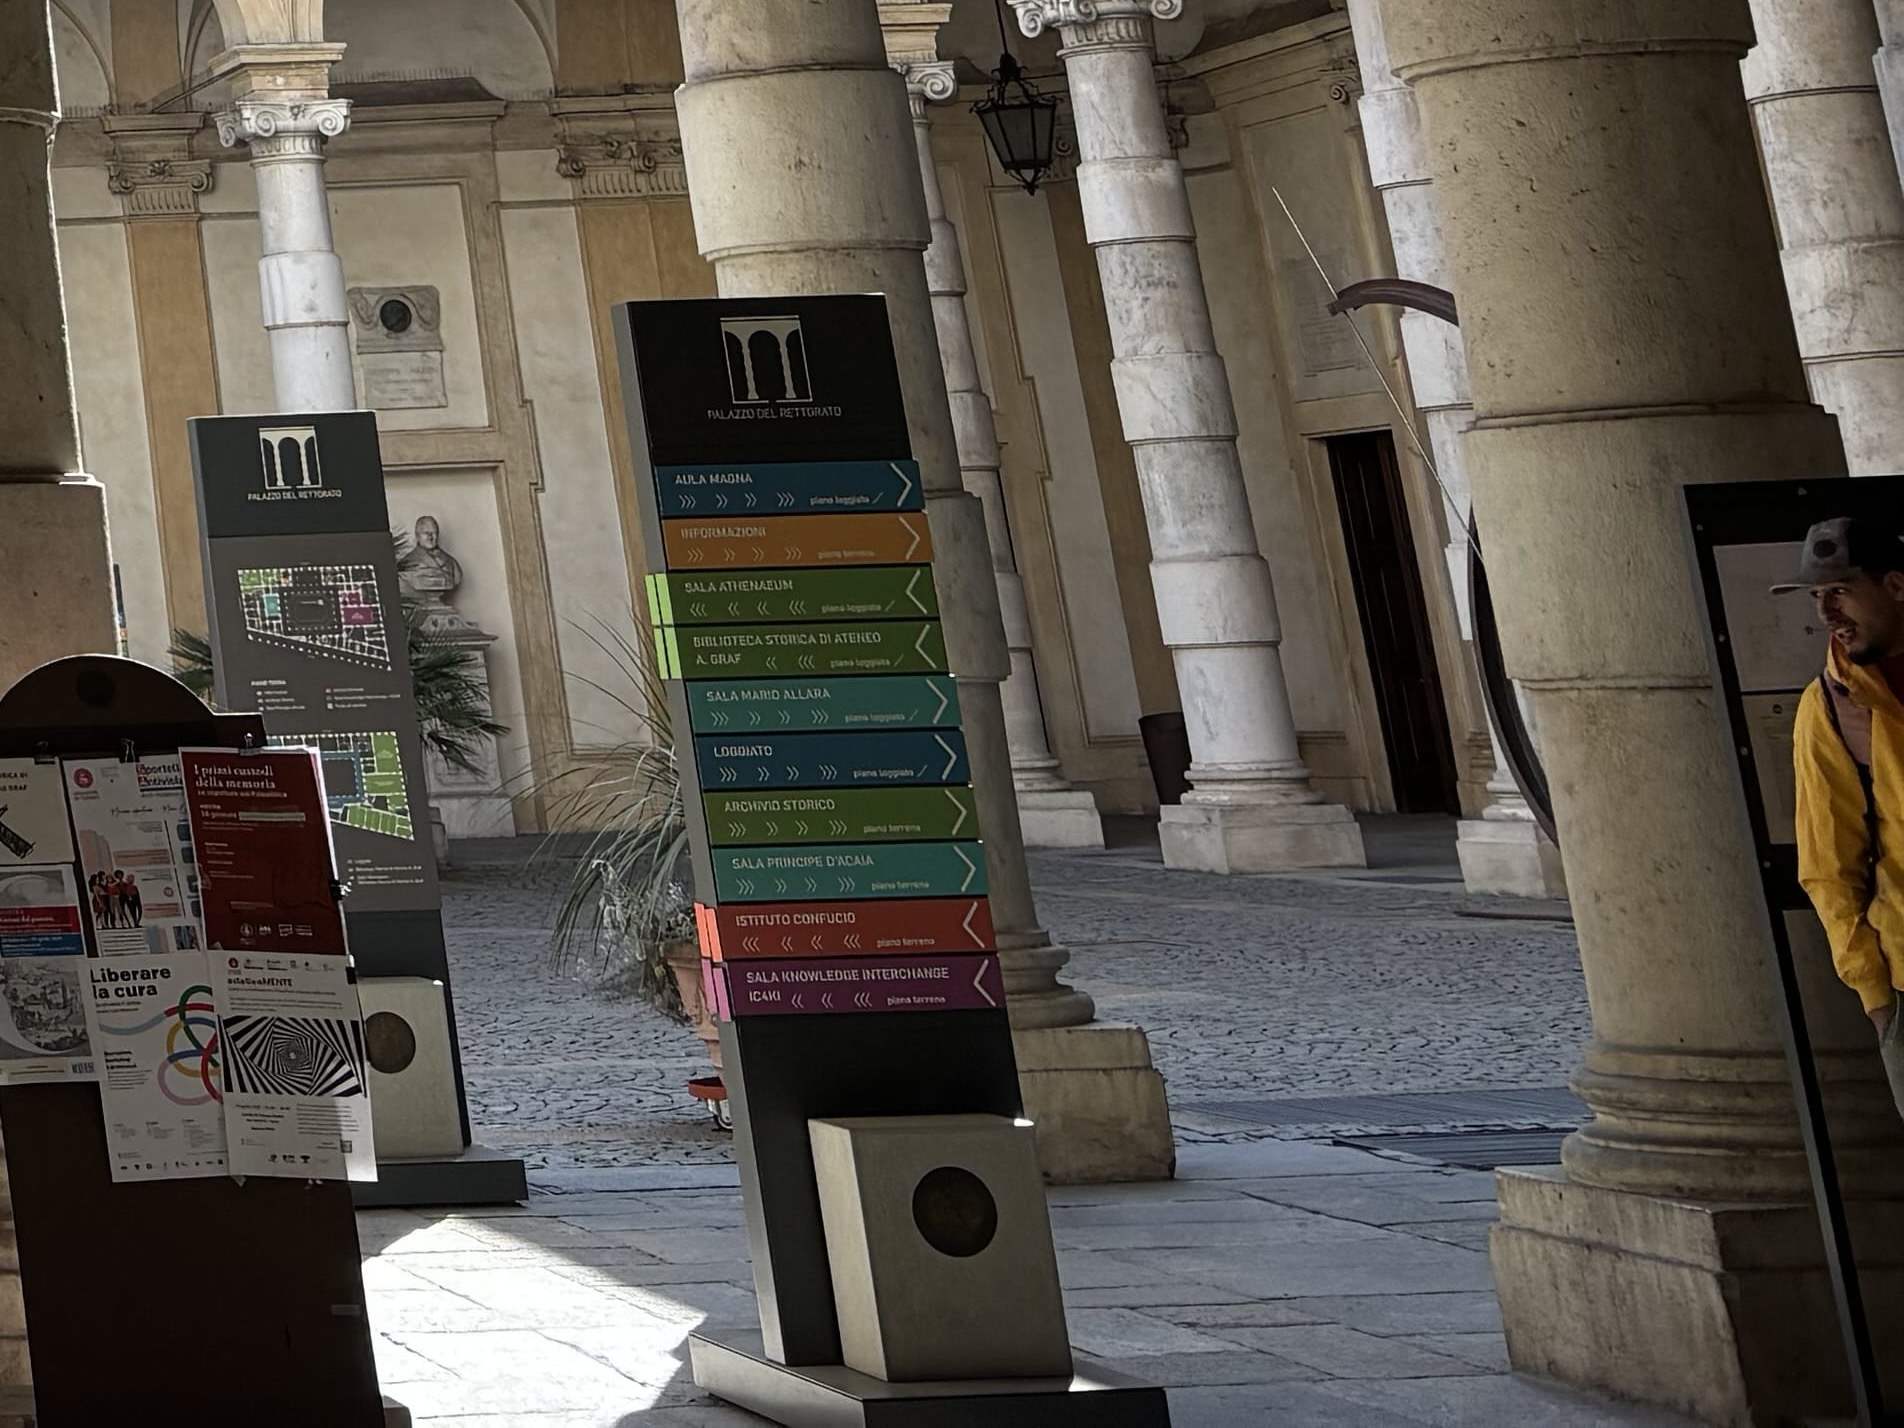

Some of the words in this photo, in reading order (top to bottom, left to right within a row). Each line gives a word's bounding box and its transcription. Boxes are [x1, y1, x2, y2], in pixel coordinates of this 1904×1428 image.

[707, 408, 755, 420] PALAZZO
[756, 407, 778, 419] DEL
[779, 406, 842, 418] RETTORATO
[675, 473, 707, 485] AULA
[709, 472, 753, 484] MAGNA
[680, 527, 767, 539] INFORMAZIONI
[685, 582, 716, 593] SALA
[719, 580, 793, 592] ATHENAEUM
[693, 635, 762, 648] BIBLIOTECA
[765, 633, 816, 646] STORICA
[820, 633, 832, 644] DI
[834, 632, 881, 644] ATENEO
[710, 653, 742, 665] GRAF
[707, 690, 739, 702] SALA
[742, 689, 780, 701] MARIO
[783, 688, 831, 700] ALLARA
[714, 745, 773, 758] LOGGIATO
[201, 763, 233, 778] primi
[234, 764, 274, 777] custodi
[195, 776, 224, 788] della
[226, 777, 276, 790] memoria
[725, 800, 780, 813] ARCHIVIO
[783, 799, 835, 811] STORICO
[732, 857, 765, 869] SALA
[767, 856, 823, 868] PRINCIPE
[736, 914, 790, 927] ISTITUTO
[793, 912, 856, 925] CONFUCIO
[90, 967, 172, 983] Liberare
[746, 971, 779, 984] SALA
[781, 969, 859, 982] KNOWLEDGE
[862, 967, 949, 981] INTERCHANGE
[92, 984, 110, 1000] la
[114, 984, 158, 998] cura
[749, 990, 781, 1002] IC4KI
[887, 996, 911, 1006] piano
